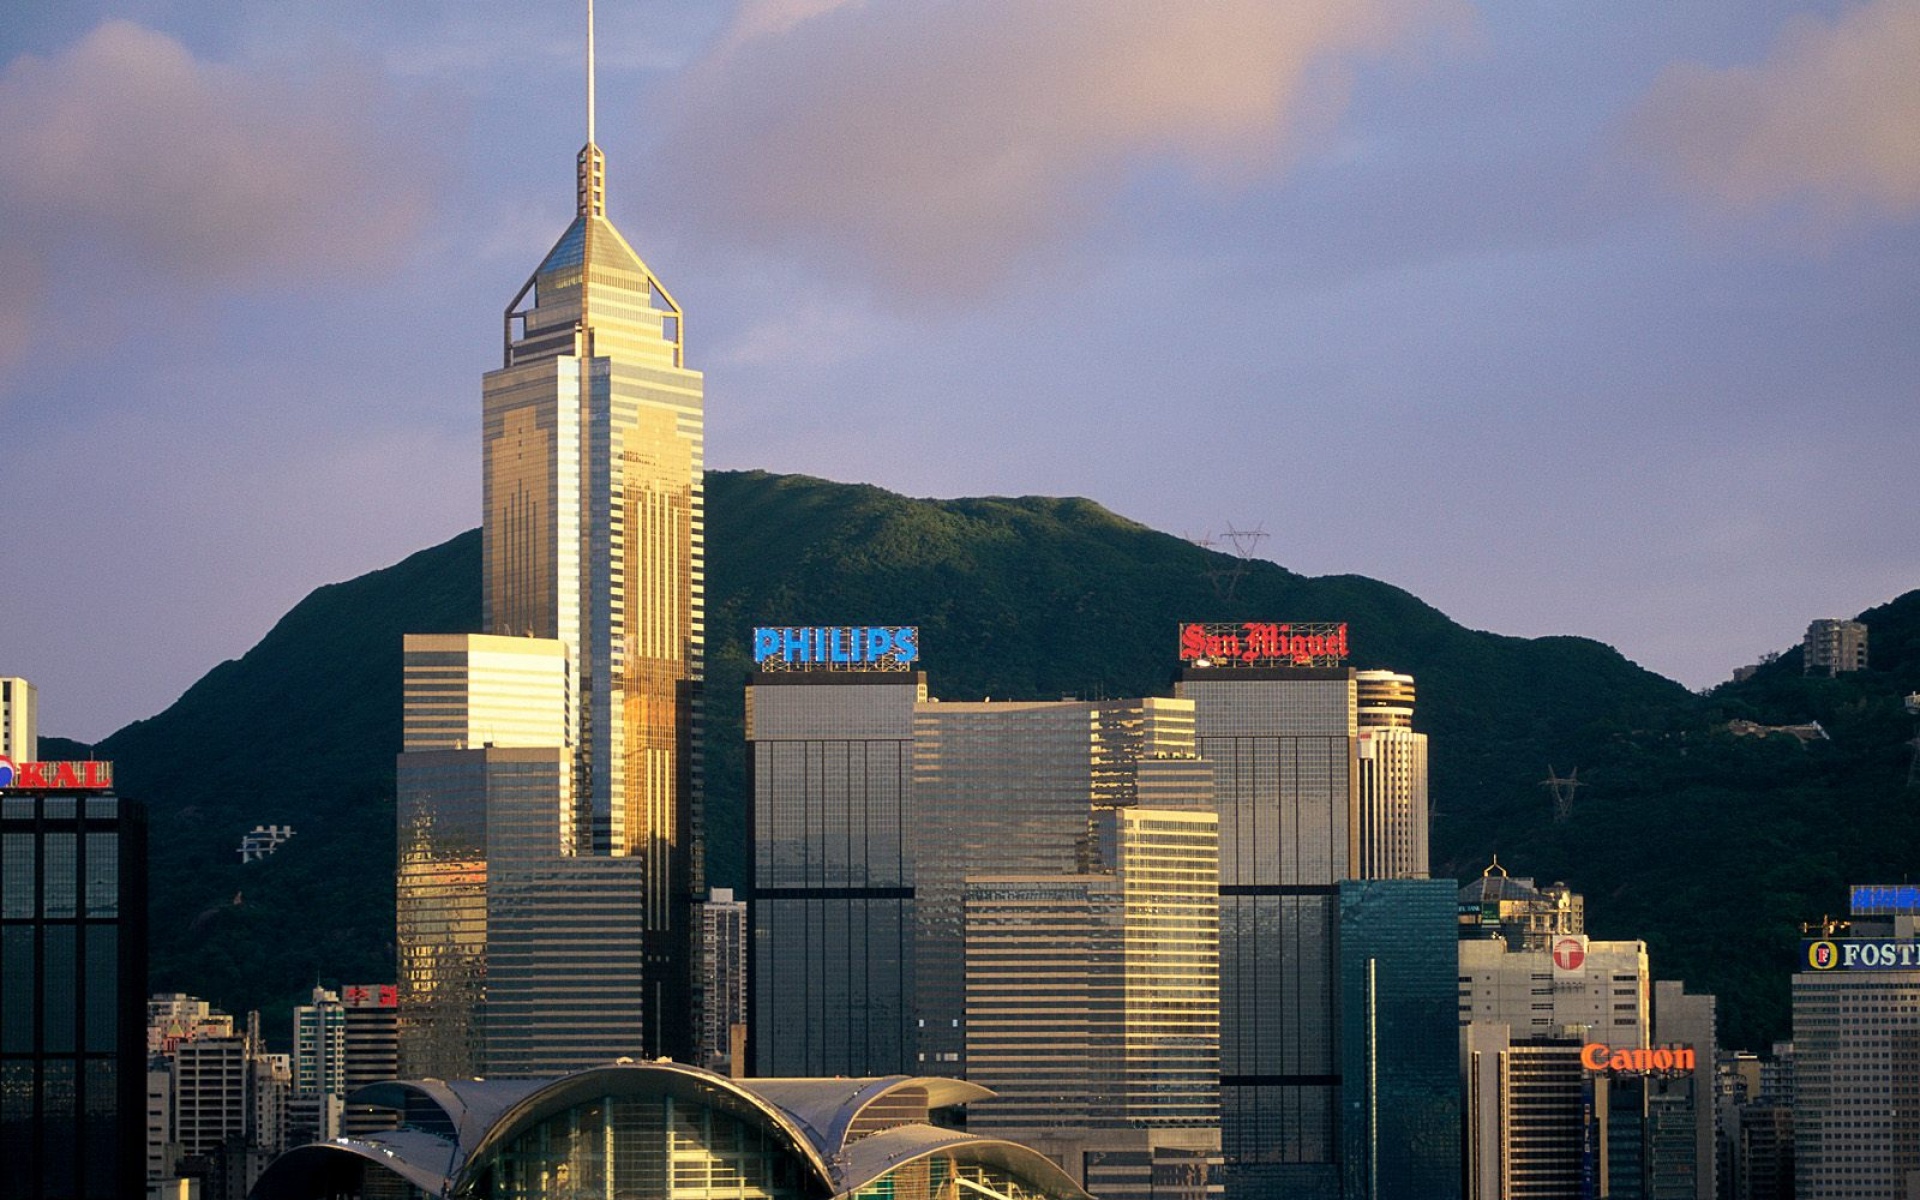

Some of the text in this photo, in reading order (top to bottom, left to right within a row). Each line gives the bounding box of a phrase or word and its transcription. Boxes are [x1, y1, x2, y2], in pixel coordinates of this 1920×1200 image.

[755, 628, 918, 662] PHILIPS
[1181, 622, 1349, 662] San Miguel
[18, 761, 111, 788] KAL
[1842, 943, 1920, 966] FOST
[1581, 1042, 1696, 1070] Canon
